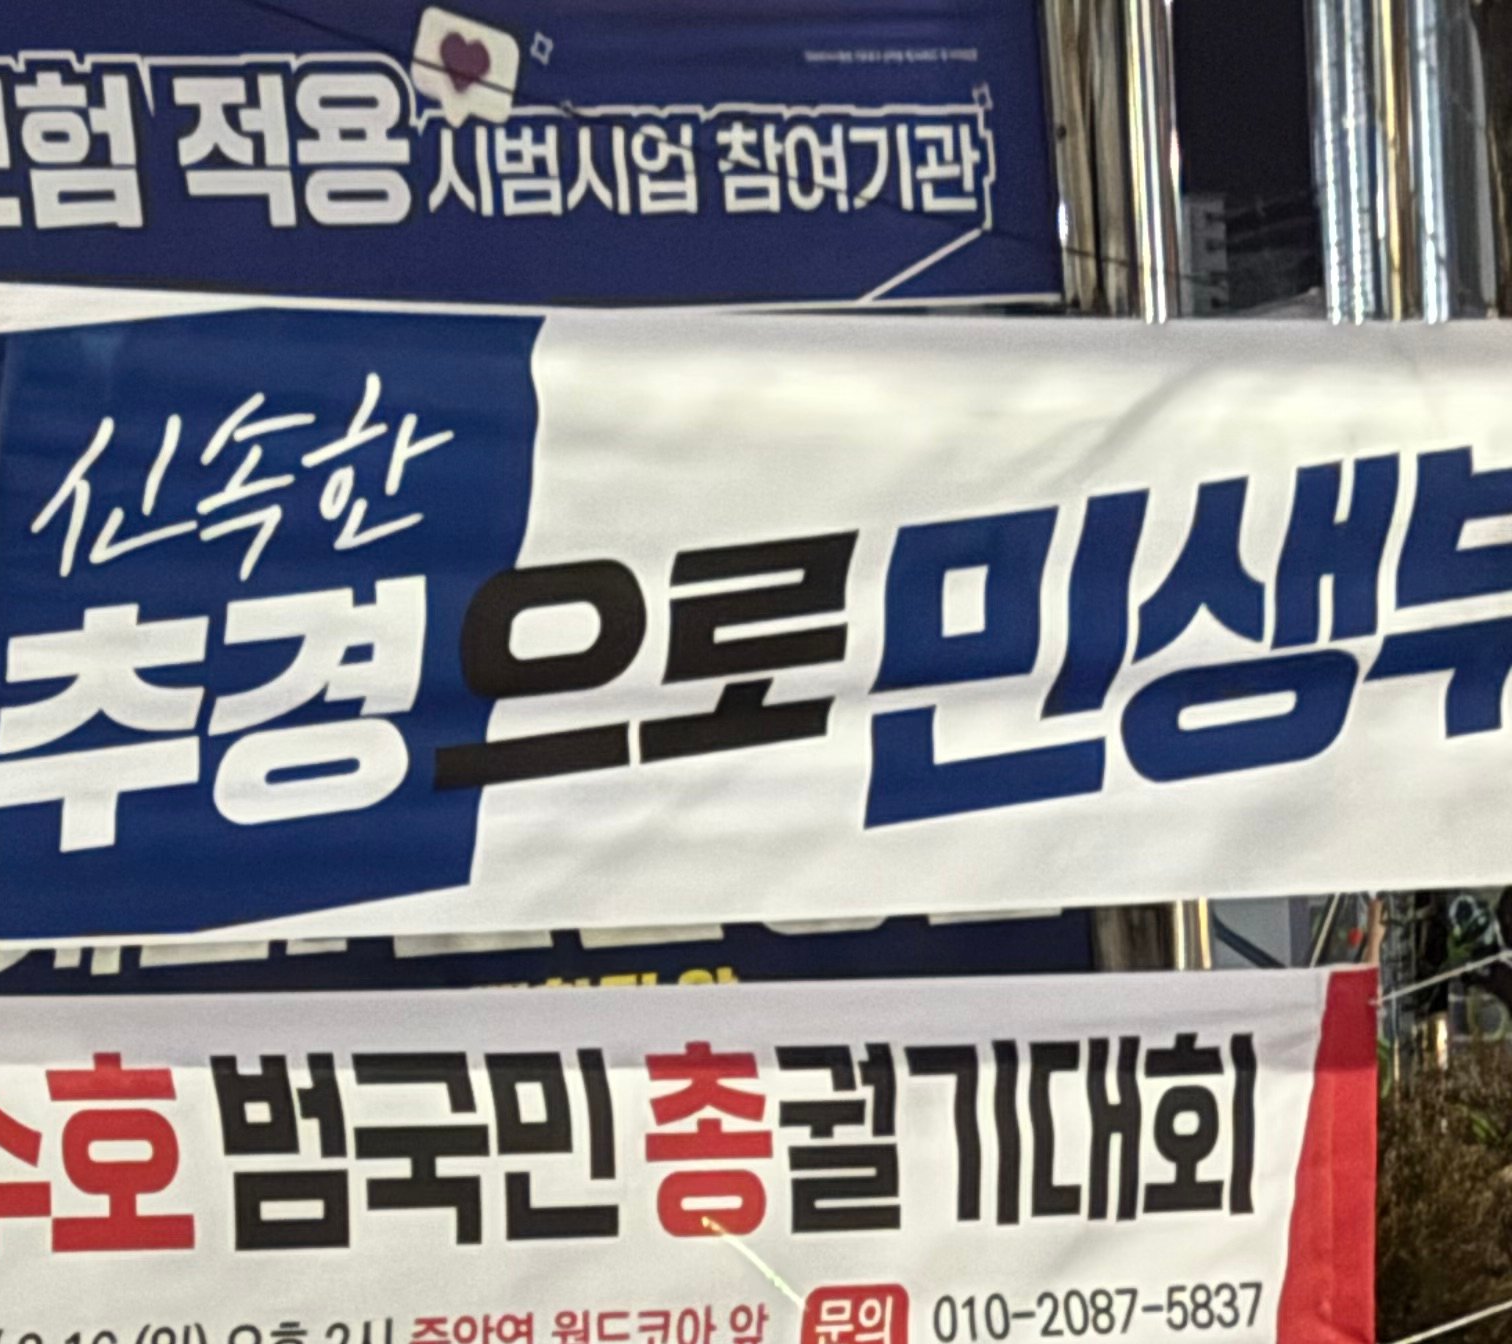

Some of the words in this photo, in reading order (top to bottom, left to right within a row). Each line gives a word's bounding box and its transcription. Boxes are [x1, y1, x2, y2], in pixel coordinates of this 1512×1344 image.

[172, 72, 412, 228] 적용
[716, 121, 981, 213] 참여기관
[30, 372, 454, 581] 신속한
[210, 1048, 619, 1252] 범국민
[644, 1032, 1257, 1237] 총궐기대회
[932, 1282, 1263, 1344] 010-2087-5837
